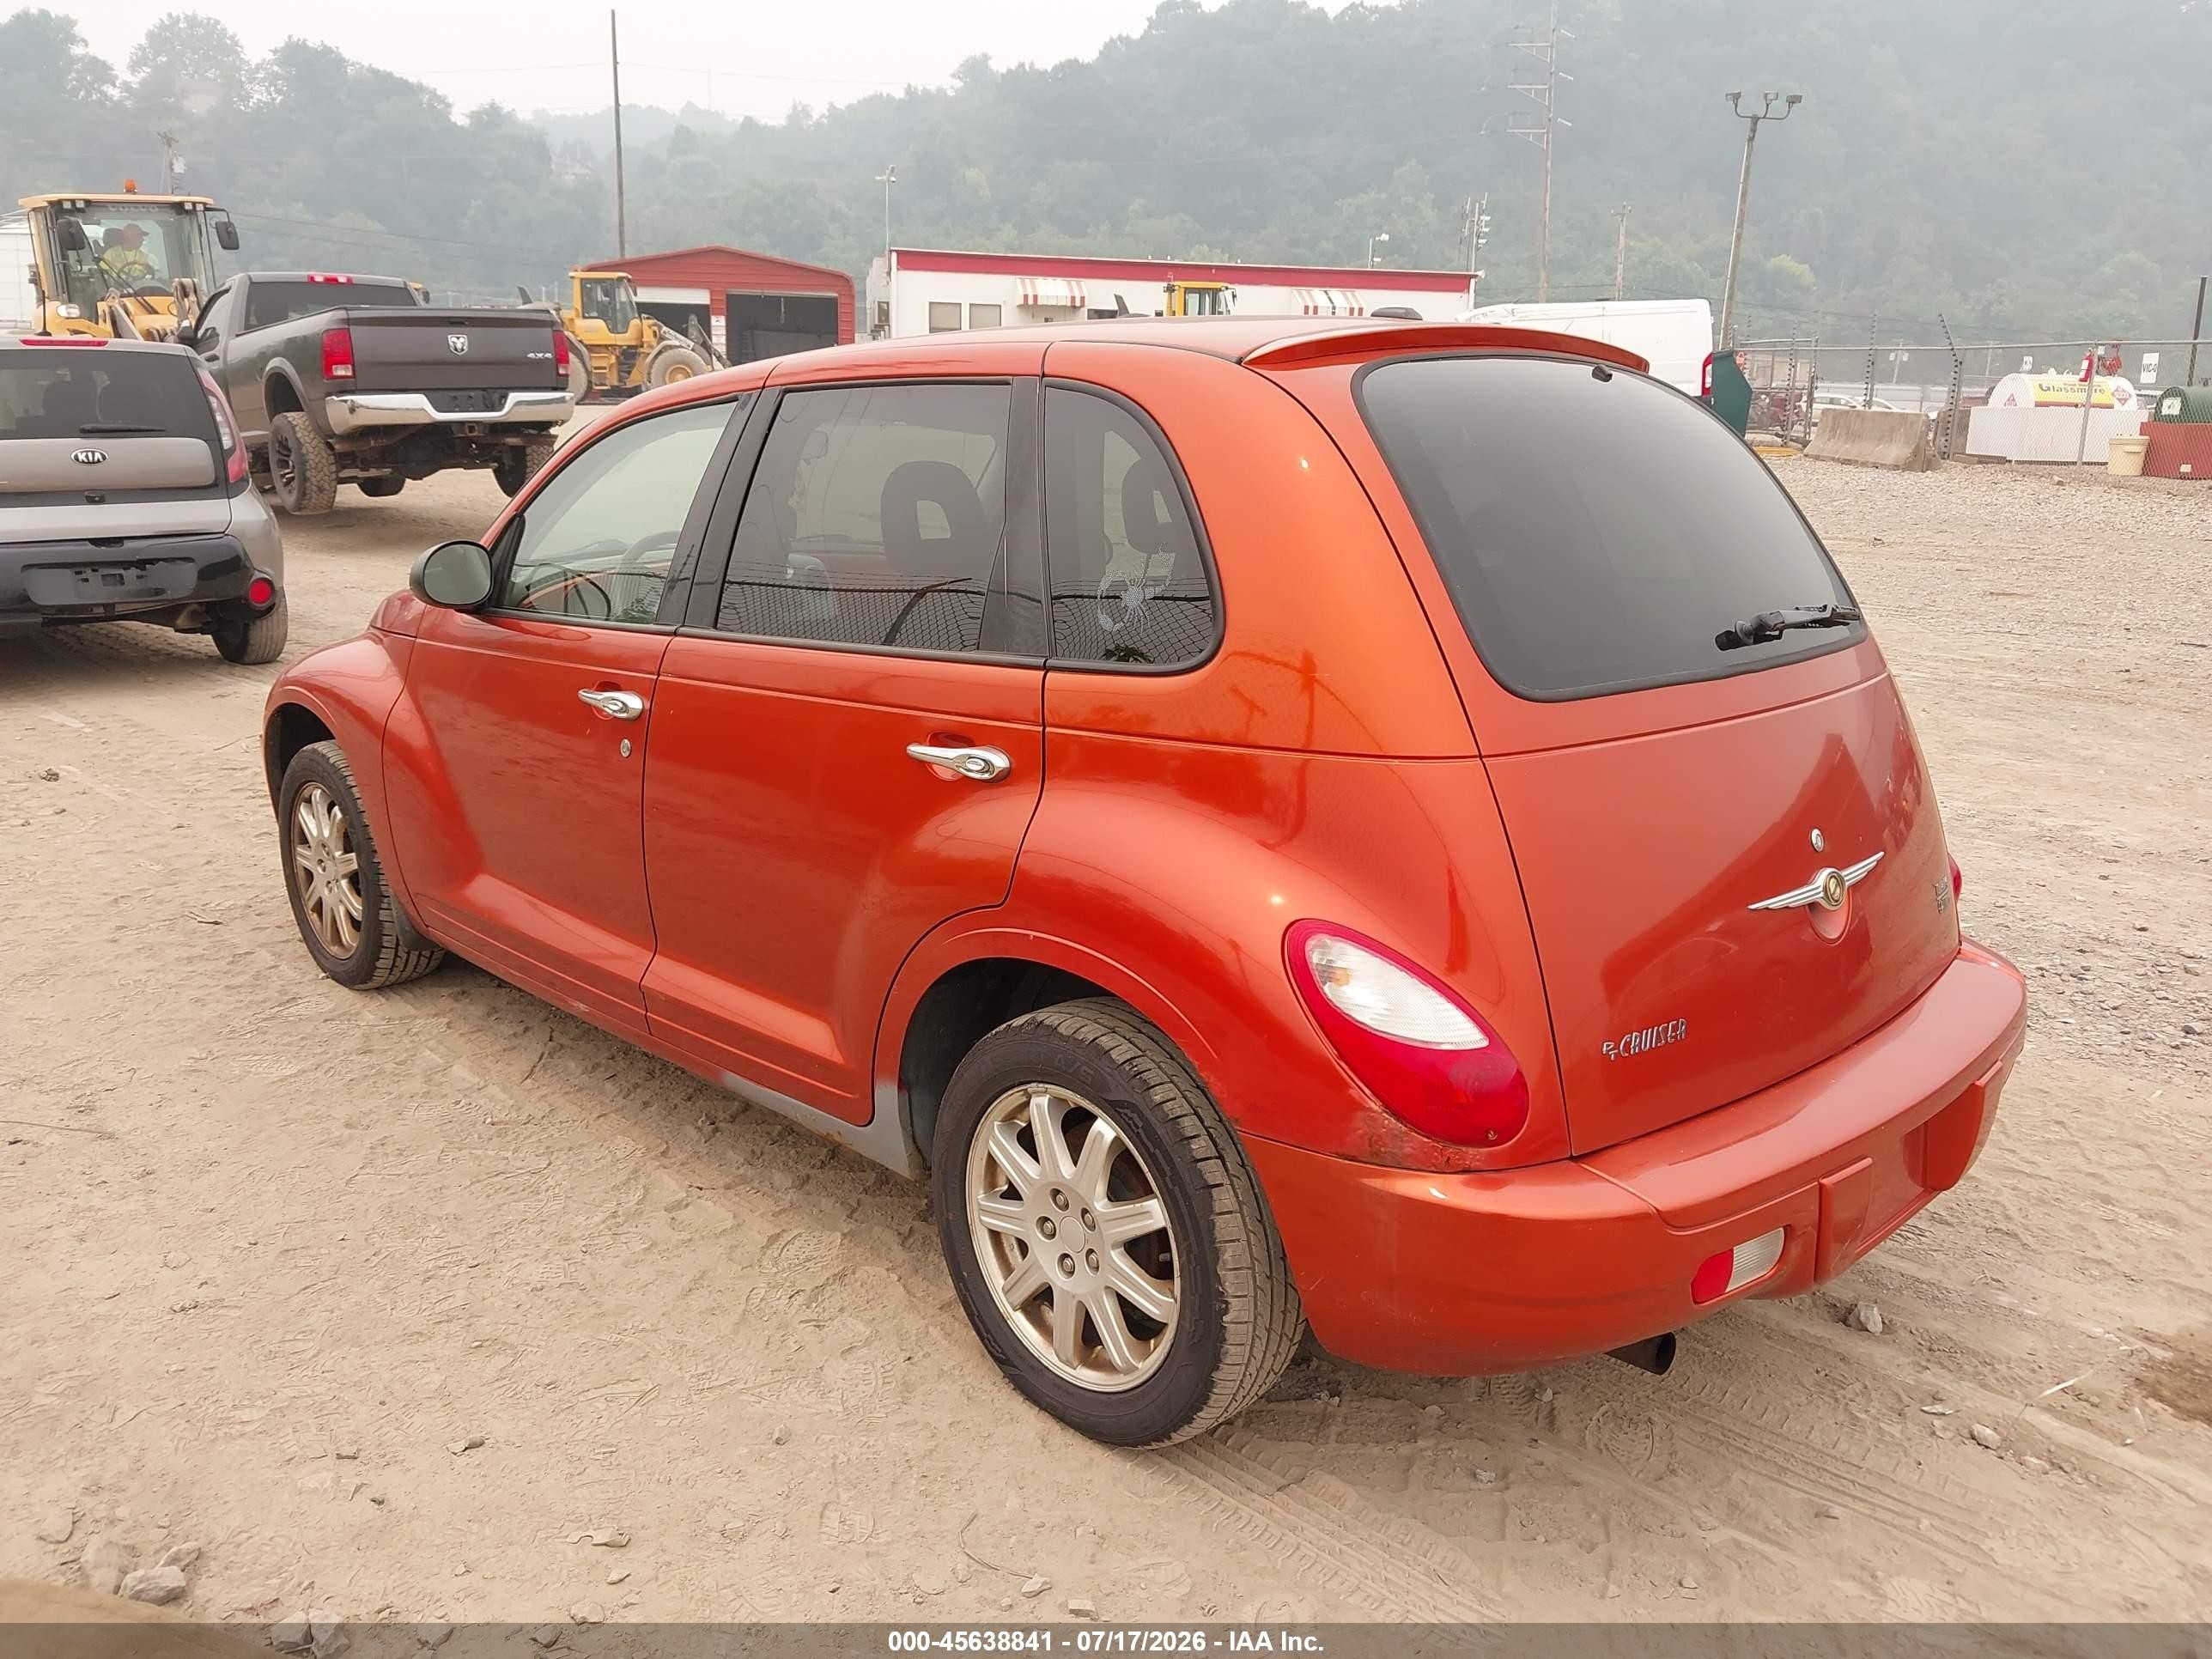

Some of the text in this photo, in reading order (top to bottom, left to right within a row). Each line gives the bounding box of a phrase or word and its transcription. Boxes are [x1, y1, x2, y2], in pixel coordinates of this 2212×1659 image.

[2039, 382, 2106, 395] Glassmre
[77, 452, 104, 463] KIA
[1620, 1018, 1687, 1057] CRUISER
